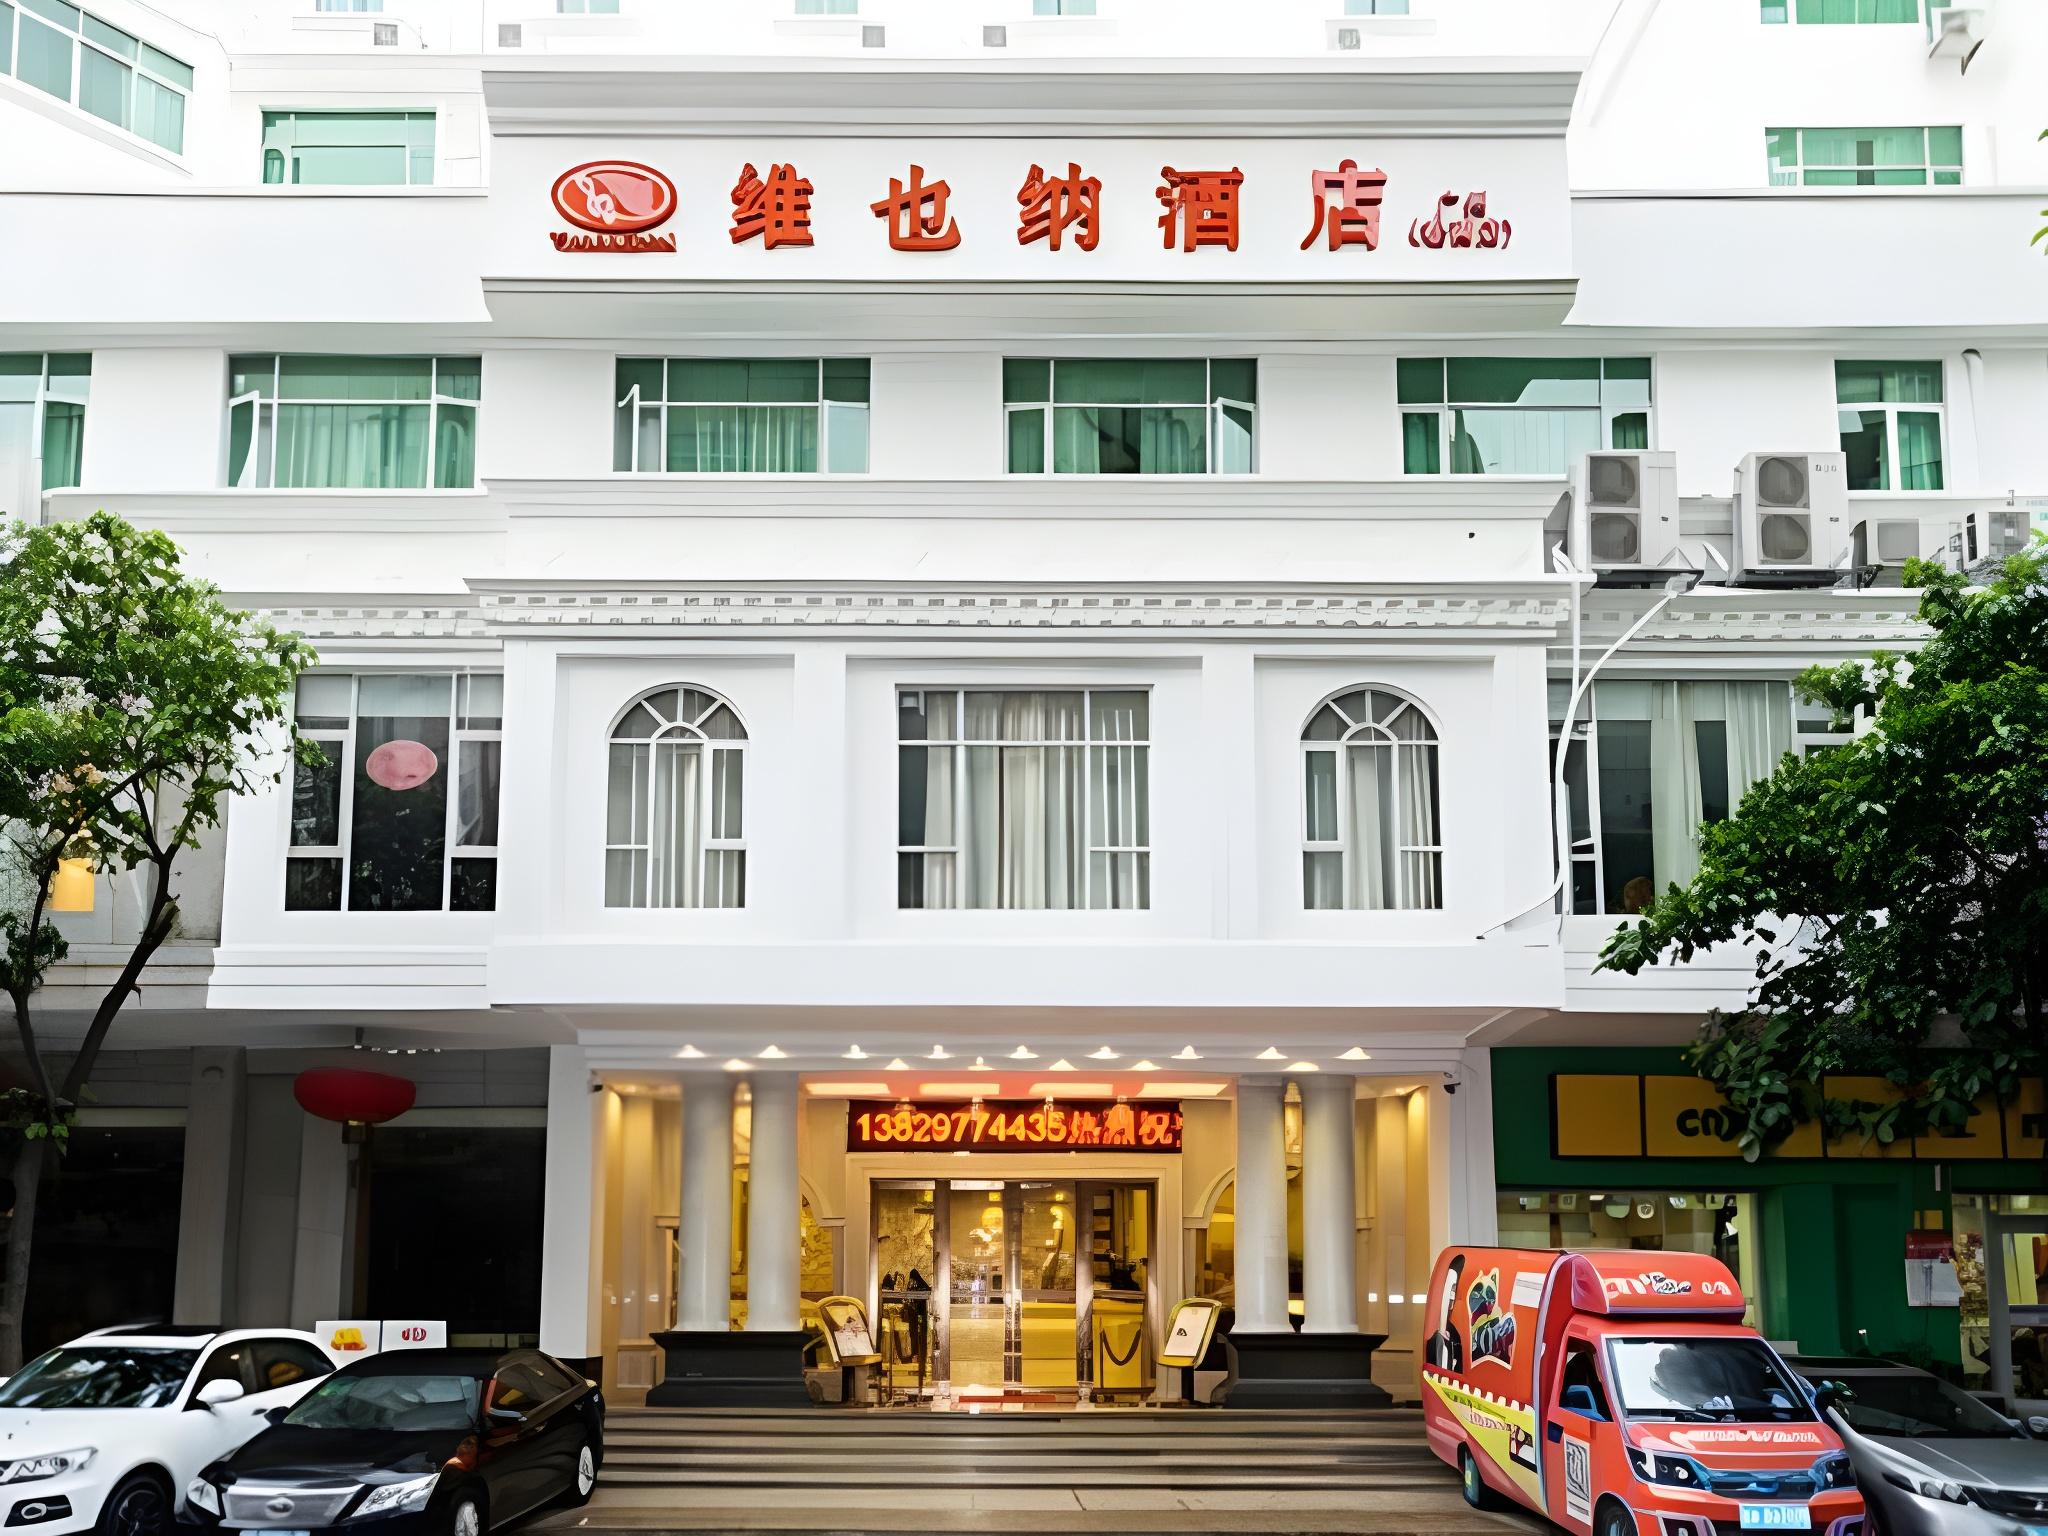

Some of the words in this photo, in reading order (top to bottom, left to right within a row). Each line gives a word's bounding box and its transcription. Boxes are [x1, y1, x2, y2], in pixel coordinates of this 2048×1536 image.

[729, 160, 1386, 252] 维也纳酒店
